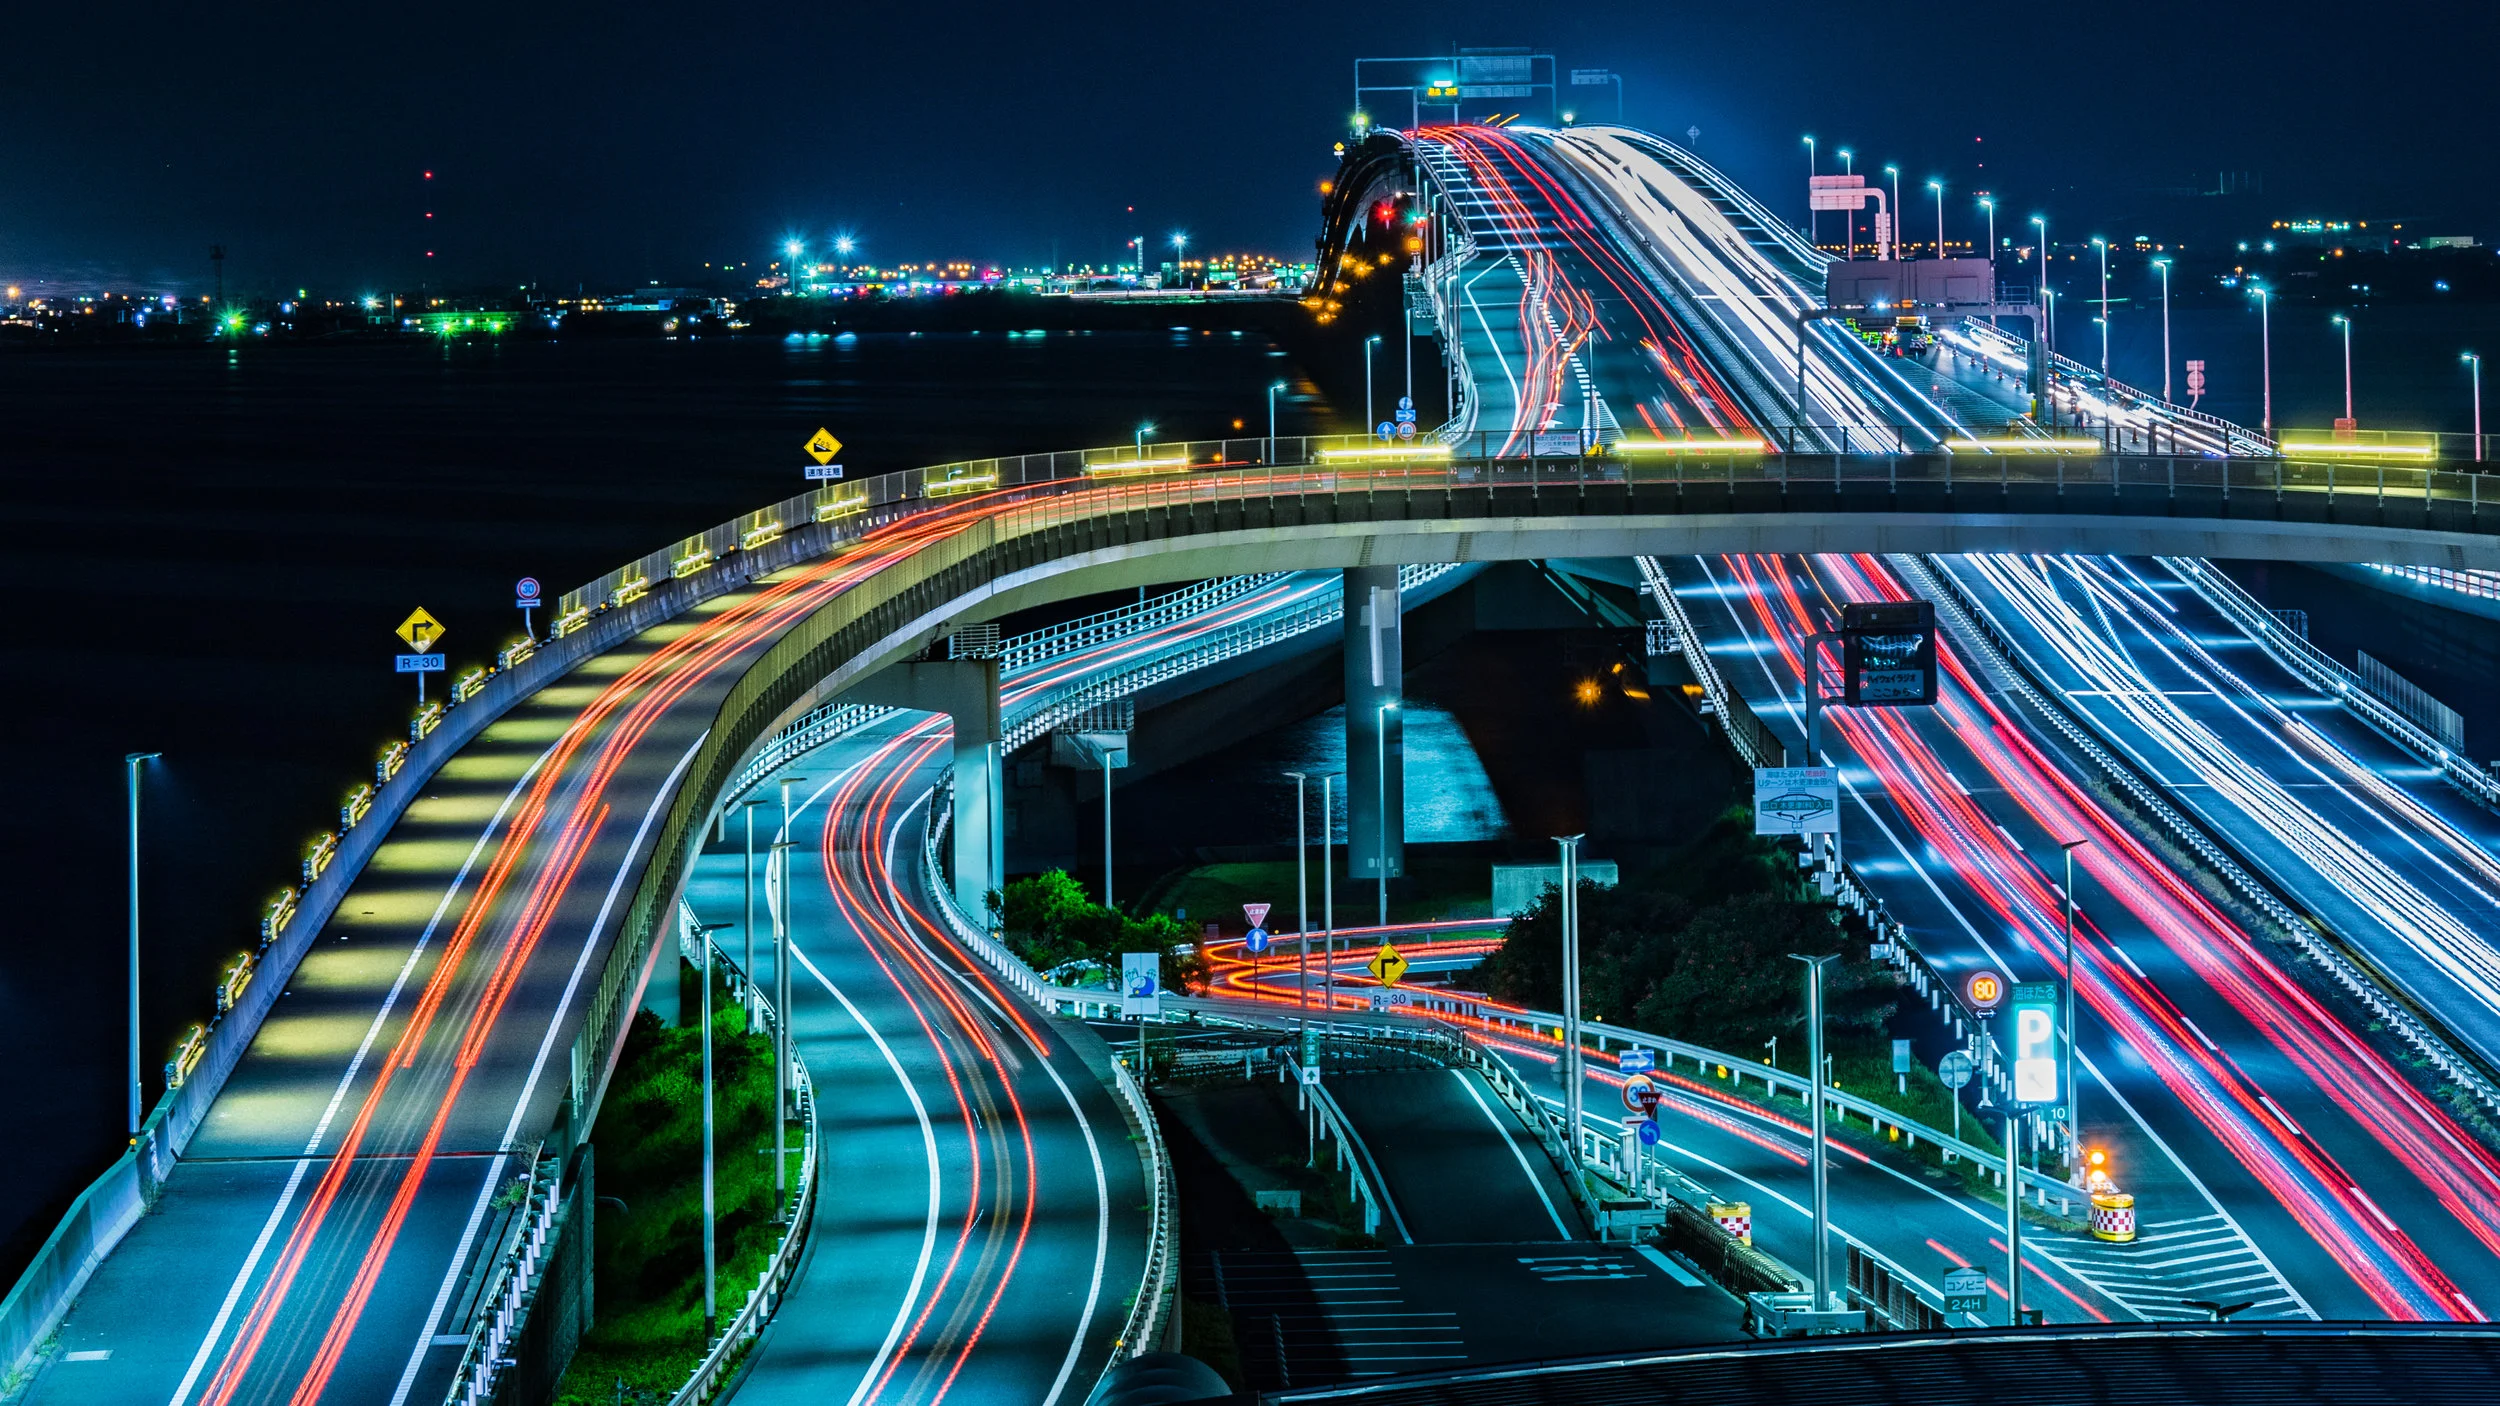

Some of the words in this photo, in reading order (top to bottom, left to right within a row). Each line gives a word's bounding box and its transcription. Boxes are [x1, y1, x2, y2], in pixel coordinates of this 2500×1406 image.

[522, 584, 535, 594] 30
[1872, 688, 1911, 698] ここから
[2012, 985, 2056, 1000] 海ほたる
[2018, 1009, 2052, 1060] P
[2051, 1108, 2066, 1119] 10
[1946, 1280, 1985, 1291] コンビニ
[1951, 1298, 1980, 1310] 24H
